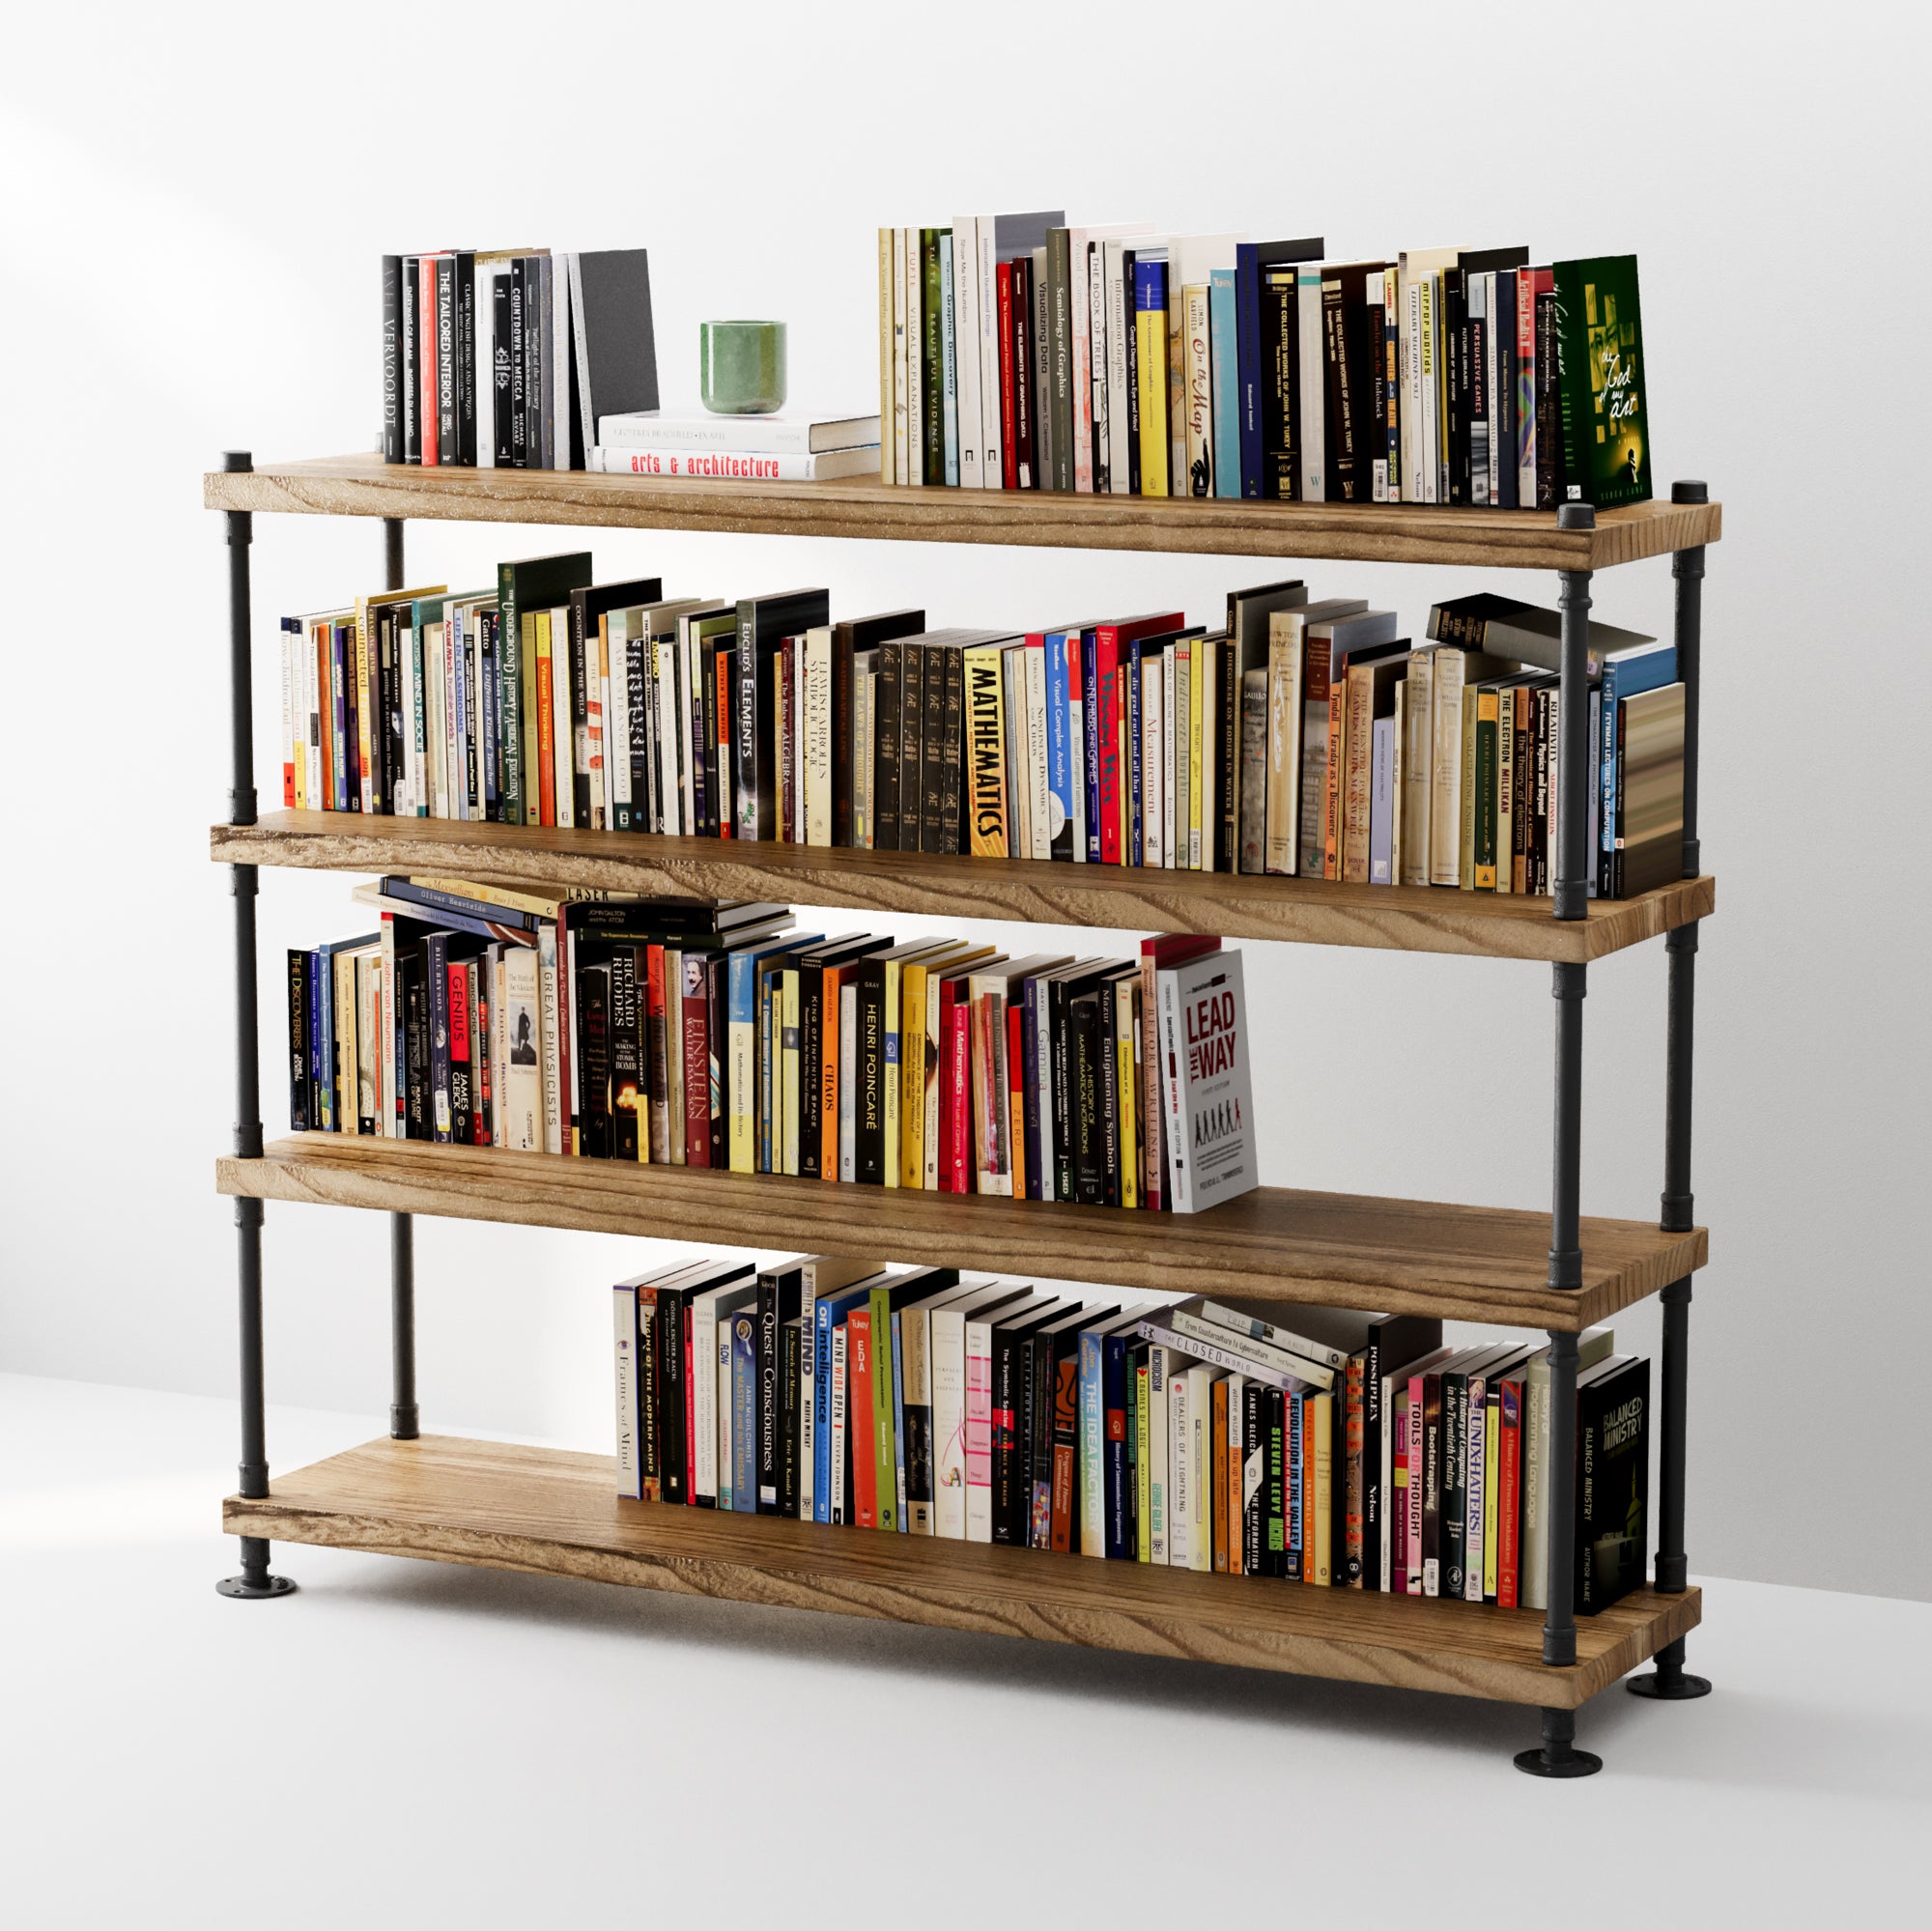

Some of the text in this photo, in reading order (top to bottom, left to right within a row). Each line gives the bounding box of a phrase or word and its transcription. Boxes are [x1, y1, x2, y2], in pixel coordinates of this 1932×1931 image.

[512, 288, 522, 351] COUNTDOWN
[1038, 281, 1049, 374] Visualizing Data
[1055, 287, 1065, 339] Semiology
[440, 271, 451, 408] THE TAILORED INTERIOR
[1056, 341, 1065, 352] of
[1337, 325, 1346, 362] COLLECTED
[1342, 389, 1349, 398] OF
[384, 319, 395, 427] VERVOORDT
[513, 366, 522, 400] MECCA
[1057, 354, 1065, 398] Graphics
[632, 453, 660, 474] arts
[688, 454, 779, 477] architecture
[456, 644, 463, 656] IN
[482, 619, 491, 649] Gatto
[577, 658, 583, 668] IN
[743, 623, 753, 757] EUCLID'S ELEMENTS
[782, 722, 789, 730] of
[857, 731, 865, 743] OF
[1055, 708, 1064, 749] Complex
[972, 667, 1002, 838] MATHEMATICS
[1056, 751, 1065, 787] Analysis
[1146, 719, 1157, 815] Measurement
[1501, 695, 1511, 813] THE ELECTRON MILLIKAN
[1604, 787, 1611, 799] ON
[1603, 800, 1611, 851] COMPUTATION
[452, 976, 464, 1041] GENIUS
[612, 957, 623, 1026] RHODES
[624, 957, 634, 1027] RICHARD
[1186, 991, 1236, 1044] LEAD
[544, 972, 556, 1126] GREAT PHYSICISTS
[694, 1019, 706, 1121] EINSTEIN
[867, 1005, 877, 1130] HENRI POINCARÉ
[1078, 1034, 1087, 1101] MATHEMATICAL
[1198, 1032, 1236, 1079] WAY
[460, 1073, 469, 1111] JAMES
[825, 1065, 834, 1111] CHAOS
[1103, 1037, 1115, 1175] Enlightening Symbols
[1089, 1114, 1094, 1124] OF
[721, 1344, 729, 1365] FLOW
[803, 1315, 812, 1376] MIND
[817, 1305, 830, 1424] on intelligence
[835, 1338, 843, 1364] MIND
[1152, 1349, 1162, 1392] MICROCOSM
[835, 1367, 843, 1391] WIDE
[1604, 1397, 1642, 1433] BALANCED
[1604, 1413, 1642, 1452] MINISTRY
[1179, 1443, 1185, 1453] OF
[1271, 1427, 1281, 1513] STEVEN LEVY
[1291, 1398, 1299, 1546] REVOLUTION IN THE VALLEY
[1426, 1427, 1436, 1511] Bootstrapping
[1470, 1415, 1482, 1532] UNIX-HATERS
[1062, 1475, 1068, 1486] of
[1268, 1518, 1283, 1551] HACKERS
